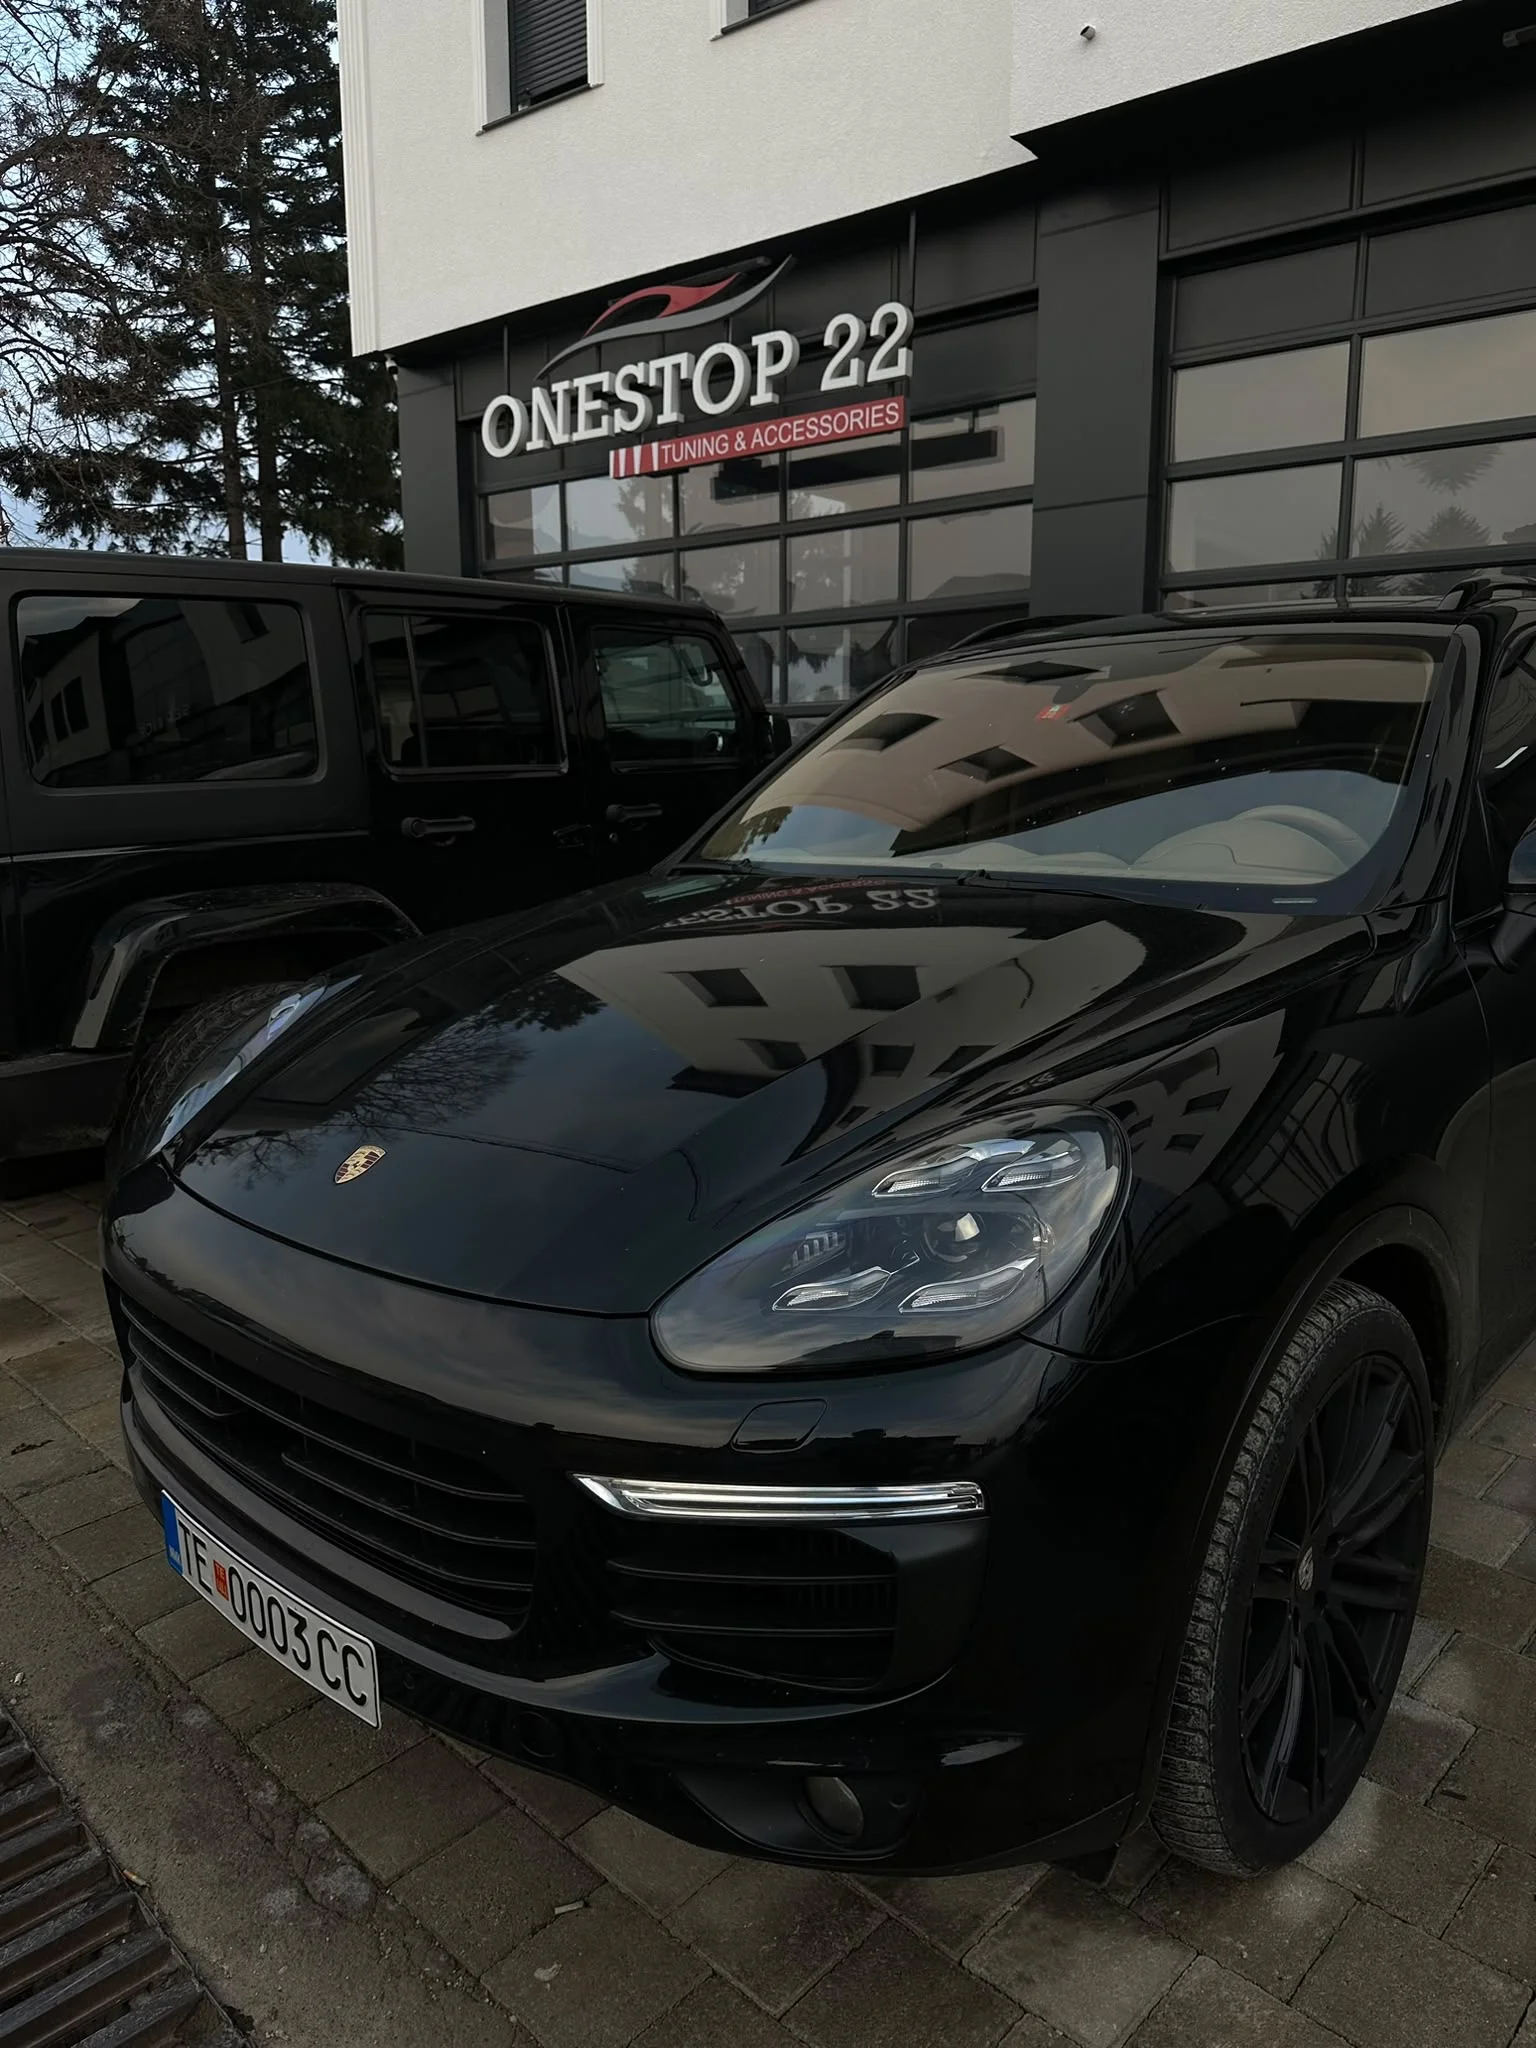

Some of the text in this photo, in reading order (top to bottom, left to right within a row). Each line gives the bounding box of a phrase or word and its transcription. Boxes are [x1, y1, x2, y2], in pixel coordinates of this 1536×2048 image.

[481, 301, 914, 458] ONESTOP 22
[661, 402, 900, 465] TUNING & ACCESSORIES
[178, 1518, 213, 1596] TE
